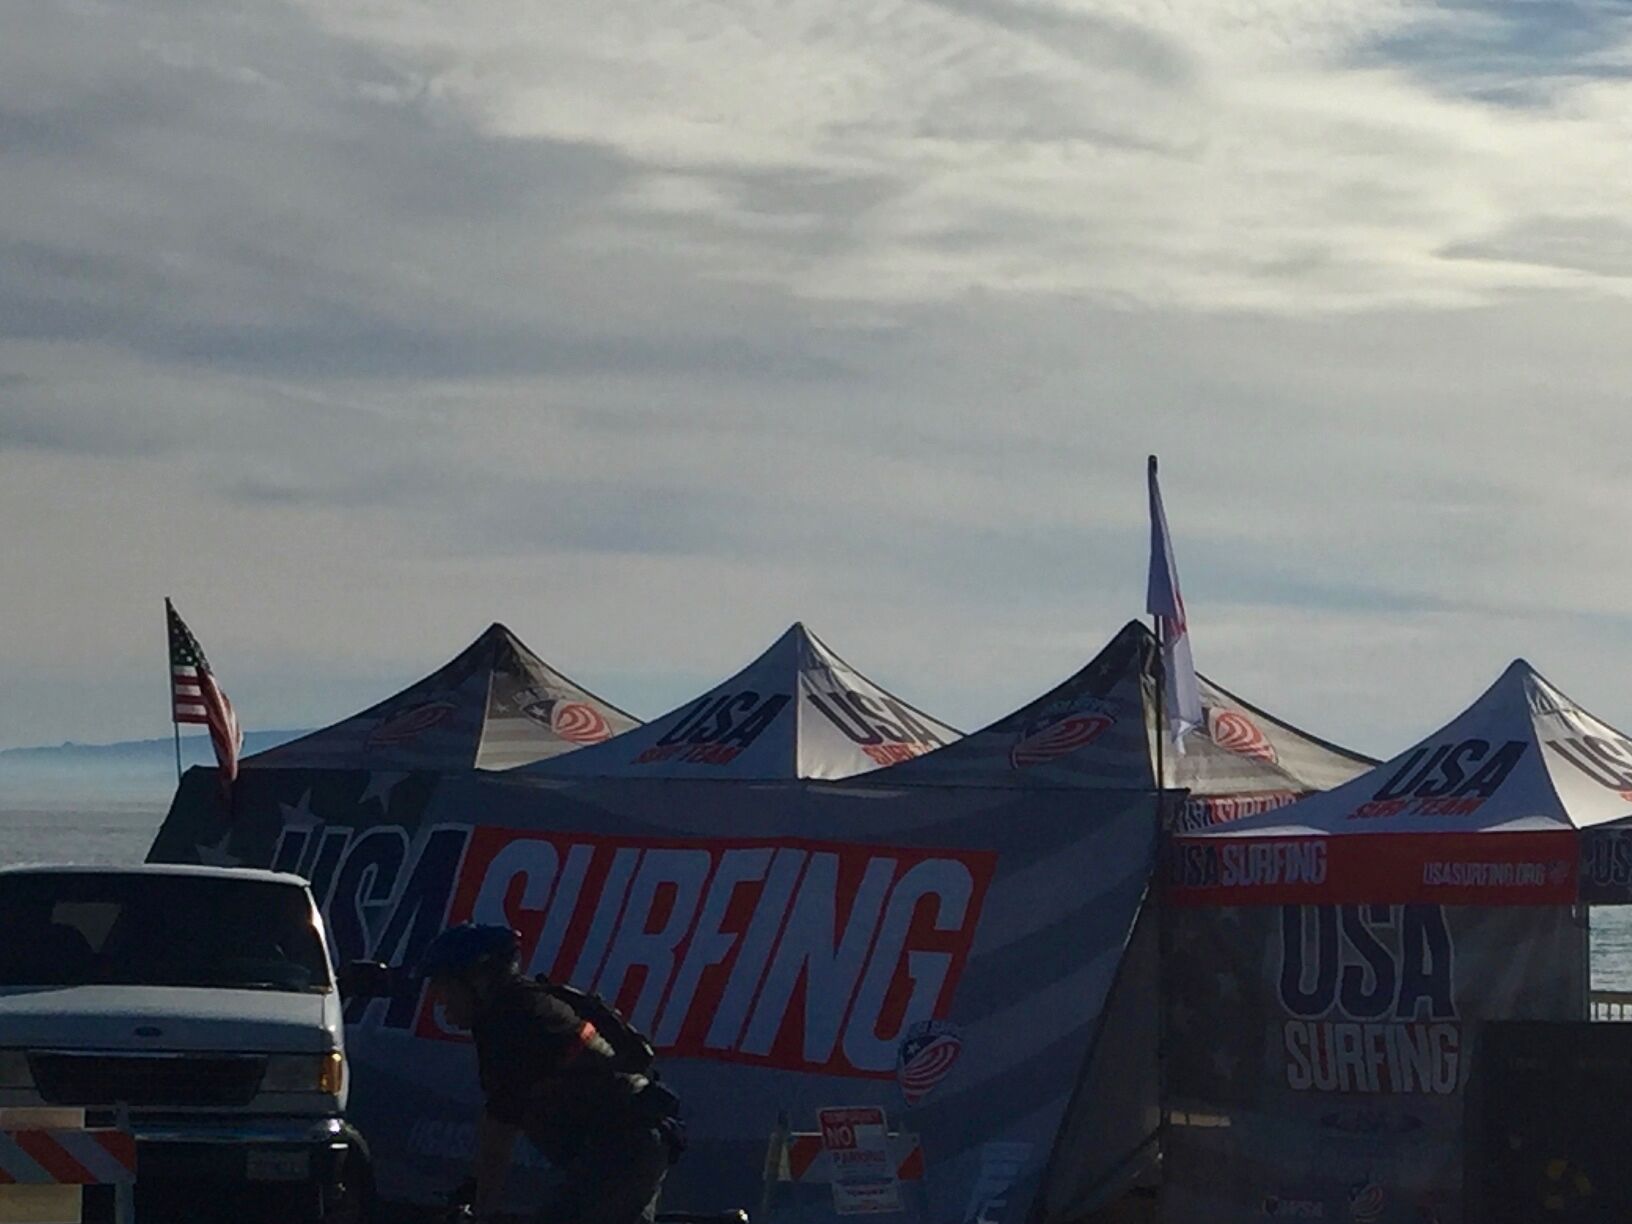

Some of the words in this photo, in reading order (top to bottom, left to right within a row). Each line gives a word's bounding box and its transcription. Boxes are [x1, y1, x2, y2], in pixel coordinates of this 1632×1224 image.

[656, 690, 793, 748] USA
[806, 690, 949, 748] USA
[1372, 739, 1529, 801] USA
[1221, 839, 1329, 888] SURFING
[430, 836, 975, 1073] SURFING
[1278, 904, 1462, 1023] USA
[1283, 1018, 1461, 1096] SURFING
[825, 1125, 852, 1147] NO
